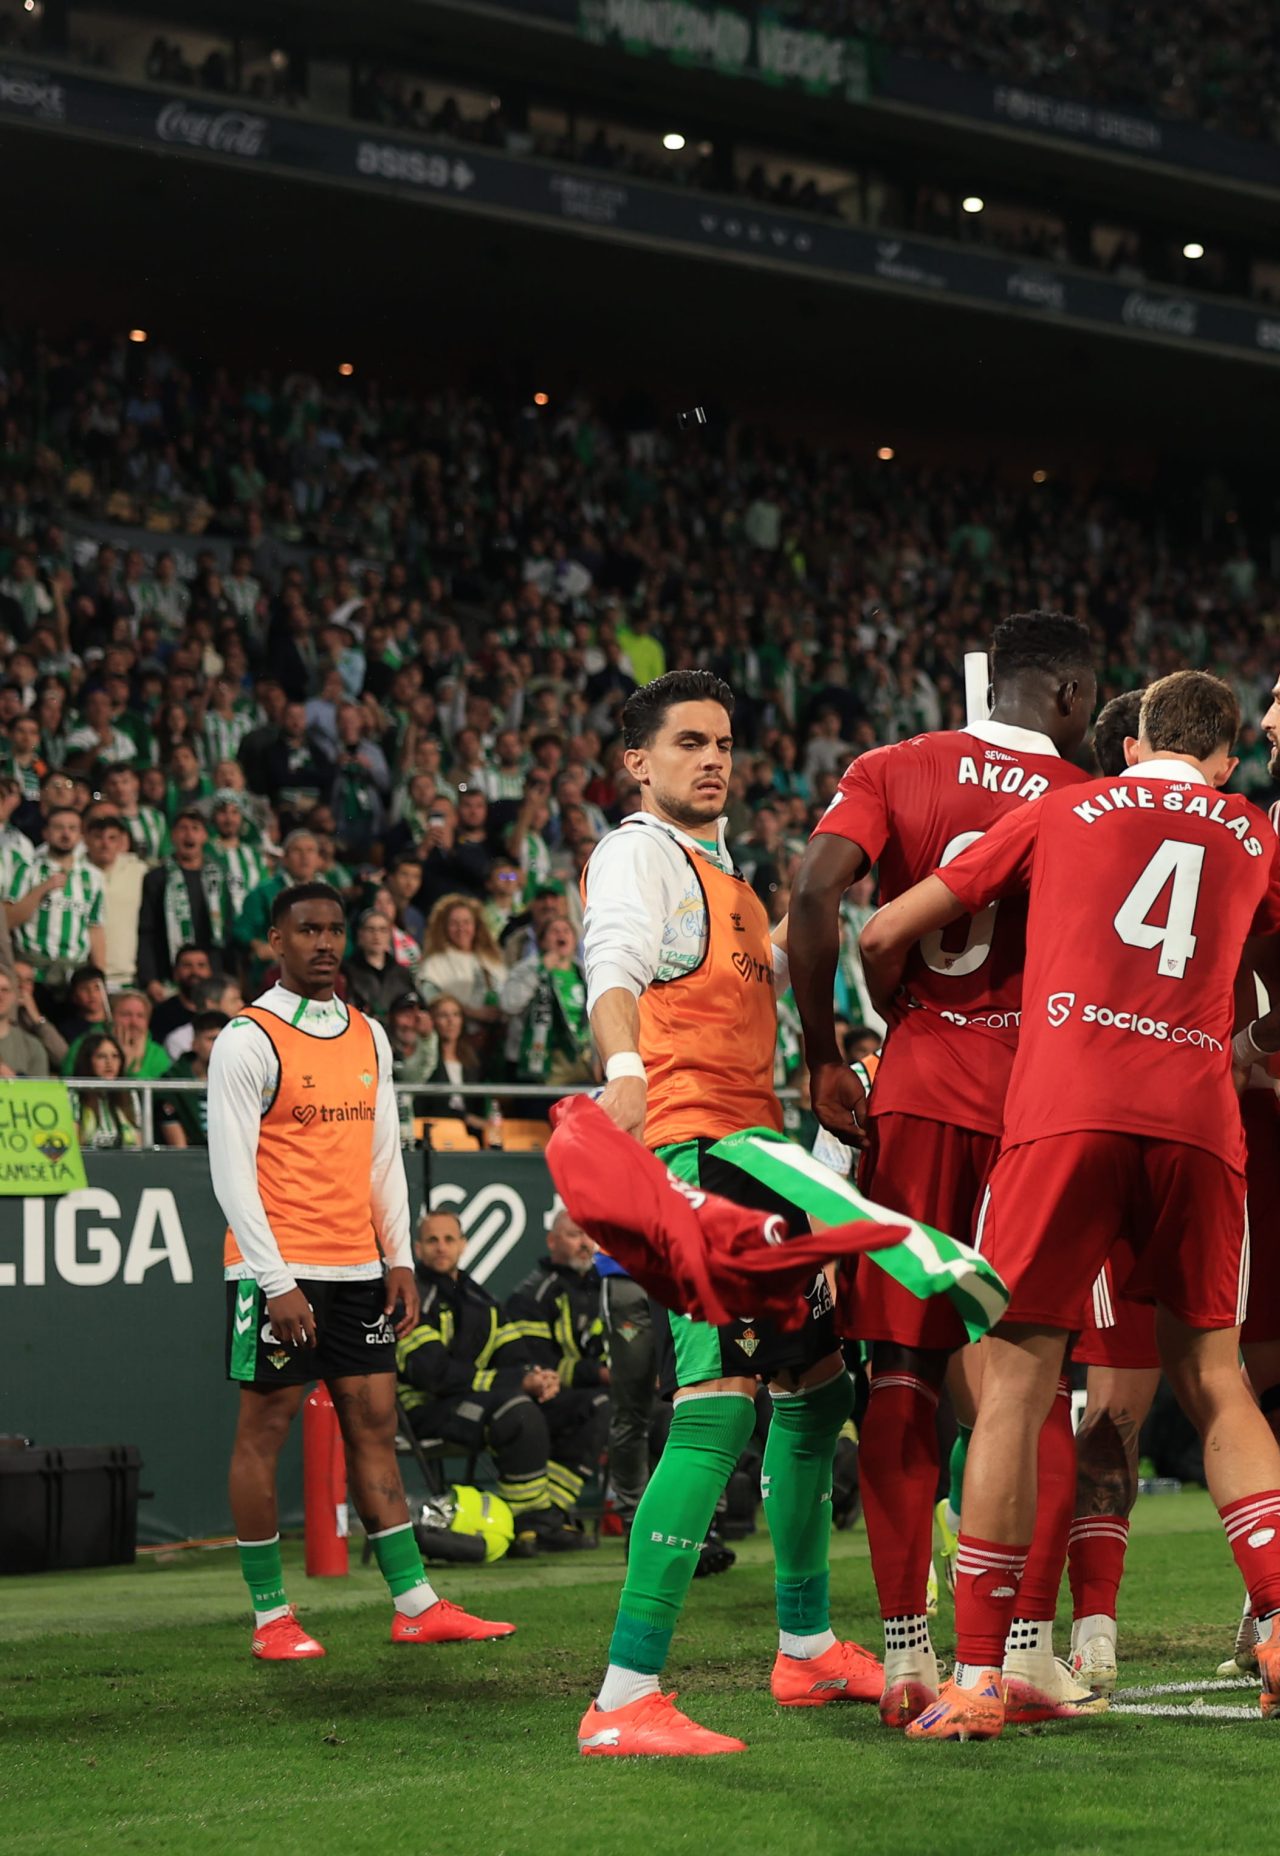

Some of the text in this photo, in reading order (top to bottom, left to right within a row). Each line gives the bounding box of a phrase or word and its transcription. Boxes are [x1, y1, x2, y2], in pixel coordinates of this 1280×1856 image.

[958, 756, 1050, 802] AKOR
[1072, 785, 1263, 857] KIKE SALAS
[1114, 839, 1205, 980] 4
[0, 1187, 194, 1287] IGA
